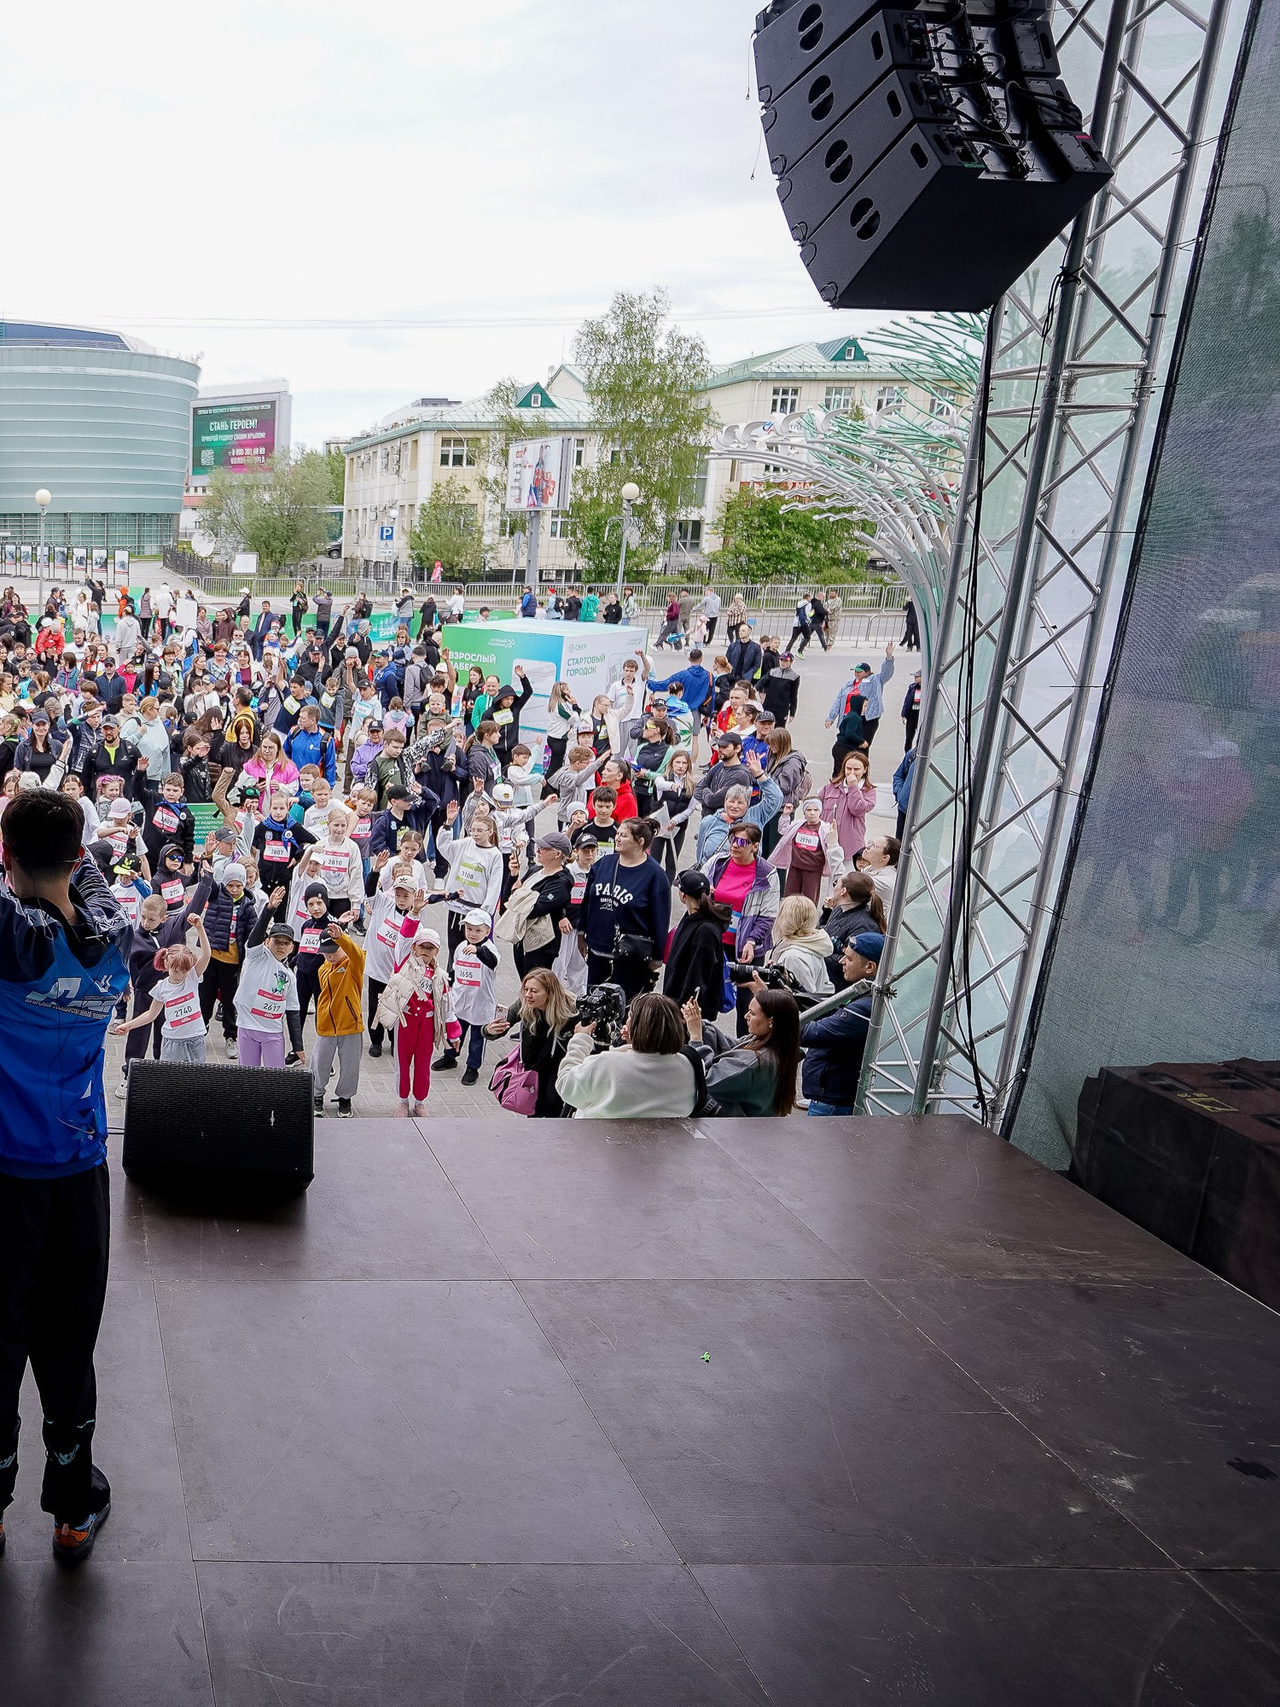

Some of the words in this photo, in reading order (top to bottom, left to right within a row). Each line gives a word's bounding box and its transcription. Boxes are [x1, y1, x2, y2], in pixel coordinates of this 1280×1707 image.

[209, 420, 229, 431] СТАНЬ
[230, 418, 258, 430] ГЕРОЕМ!
[449, 651, 497, 665] ВЗРОСЛЫЙ
[567, 653, 606, 667] СТАРТОВЫЙ
[566, 666, 597, 677] ГОРОДОК
[328, 858, 343, 867] 2810
[595, 882, 634, 904] PARIS
[174, 1005, 193, 1017] 2740
